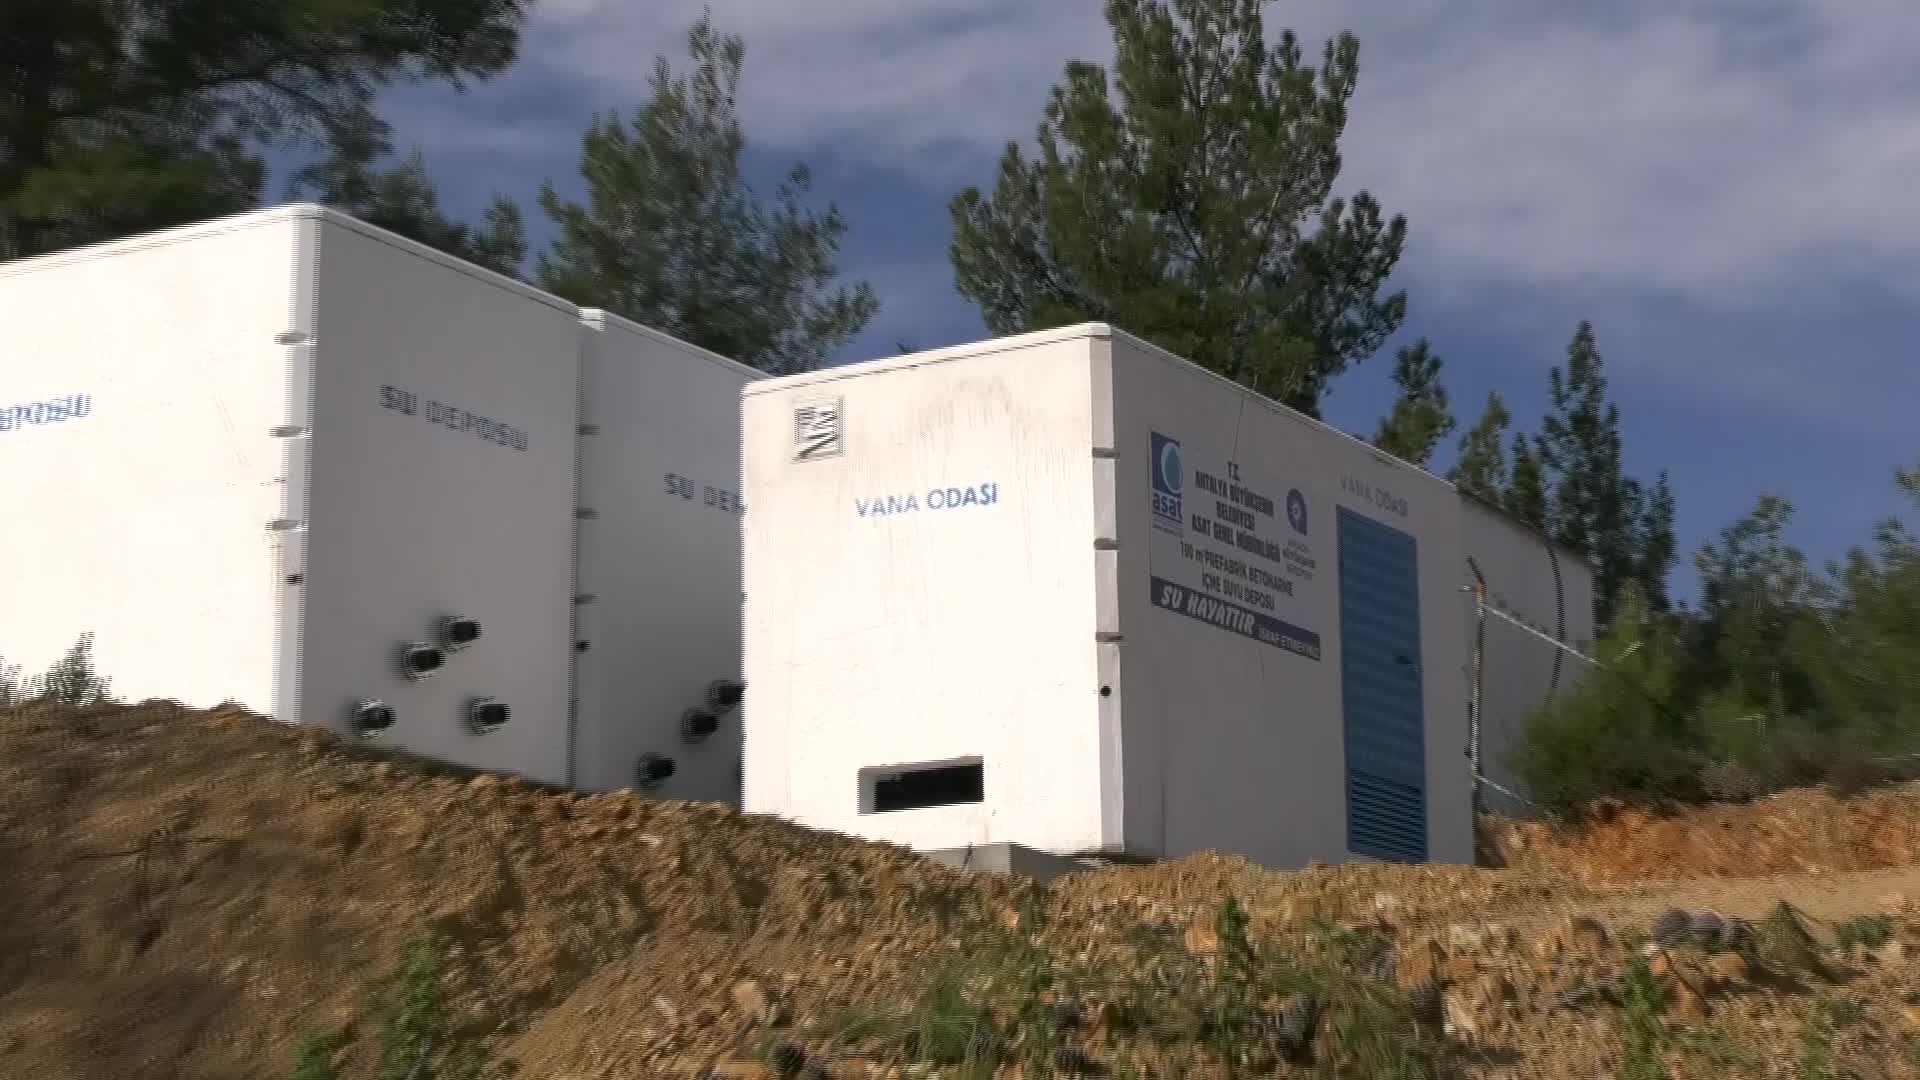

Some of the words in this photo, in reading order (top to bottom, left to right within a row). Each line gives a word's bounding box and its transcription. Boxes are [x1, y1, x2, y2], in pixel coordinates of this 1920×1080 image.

[379, 384, 416, 416] SU
[426, 400, 528, 452] DEPOSU
[664, 472, 694, 500] SU
[855, 494, 919, 517] VANA
[927, 483, 998, 509] ODASI
[1195, 470, 1228, 499] ANTALYA
[1152, 491, 1184, 521] asat
[1192, 513, 1211, 537] ASAT
[1213, 522, 1234, 546] GENEL
[1160, 585, 1182, 609] SU
[1188, 591, 1255, 636] HAYATTIR
[1244, 587, 1275, 611] DEPOSU
